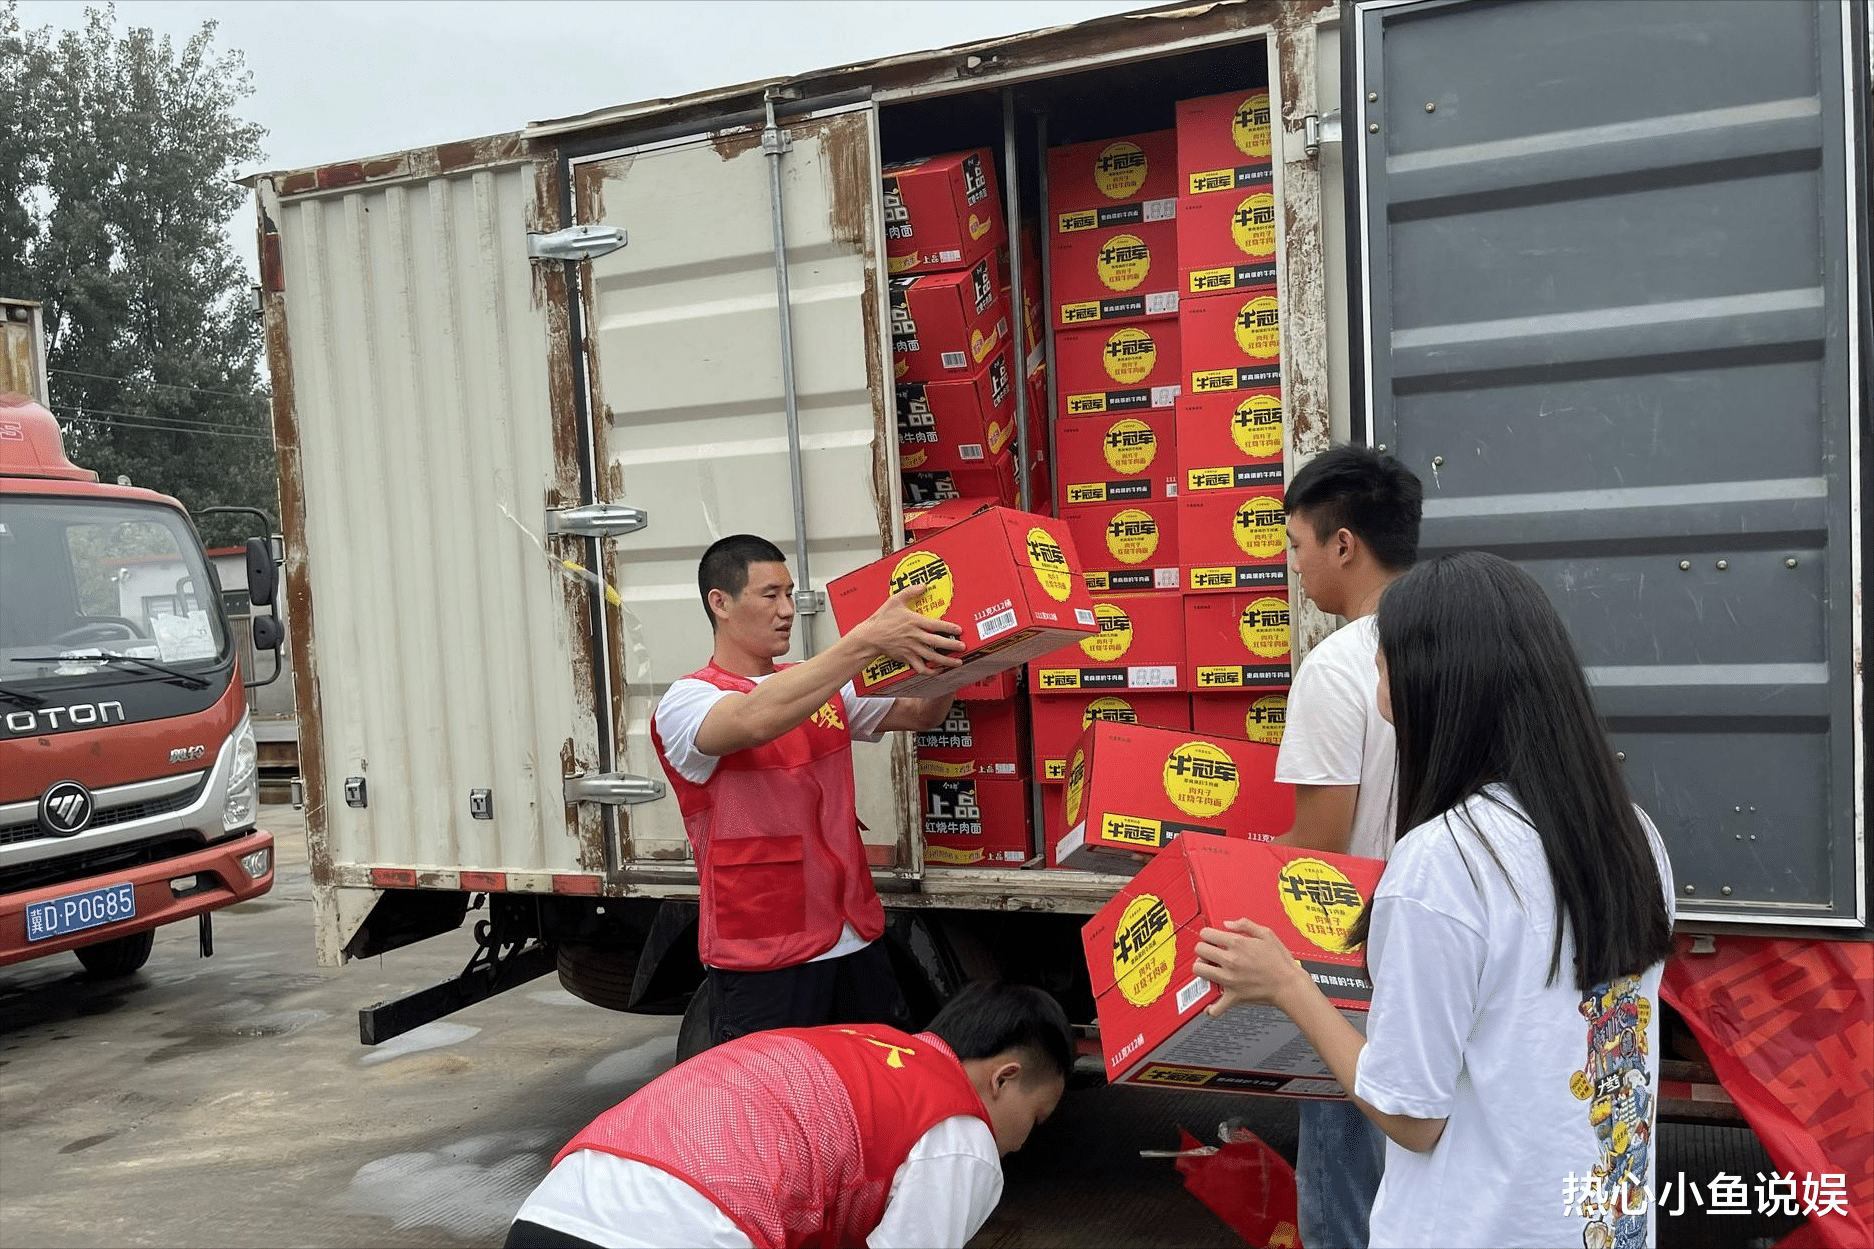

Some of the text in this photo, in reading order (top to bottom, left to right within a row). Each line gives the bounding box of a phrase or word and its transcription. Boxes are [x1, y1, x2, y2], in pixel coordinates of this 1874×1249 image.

[1097, 151, 1146, 171] 牛冠军
[1193, 175, 1231, 190] 牛冠军
[1062, 216, 1096, 230] 牛冠军
[1235, 206, 1275, 227] 牛冠
[887, 225, 914, 239] 肉面
[1100, 244, 1148, 265] 牛冠军
[1194, 274, 1232, 289] 牛冠军
[1064, 307, 1098, 321] 牛冠军
[1238, 309, 1279, 329] 牛冠
[893, 340, 920, 352] 肉面
[1106, 339, 1154, 357] 牛冠军
[1196, 376, 1234, 389] 牛冠军
[897, 397, 935, 426] 品
[1071, 399, 1104, 411] 牛冠军
[1106, 430, 1154, 448] 牛冠军
[1193, 473, 1230, 486] 牛冠军
[1071, 488, 1104, 501] 牛冠军
[1109, 521, 1155, 537] 牛冠军
[1028, 540, 1065, 564] 牛冠军
[890, 559, 948, 595] 牛冠军
[1194, 573, 1232, 586] 牛冠军
[1043, 675, 1077, 686] 牛冠军
[1201, 672, 1239, 685] 牛冠军
[928, 702, 971, 732] 品
[917, 735, 972, 748] 红烧牛肉面
[1169, 753, 1236, 782] 牛冠军
[926, 789, 981, 819] 上品
[925, 822, 982, 835] 红烧牛肉面
[1107, 820, 1156, 842] 牛冠军
[1280, 873, 1361, 907] 牛冠军
[1114, 899, 1169, 964] 牛冠军
[1133, 960, 1168, 996] 红烧牛肉面
